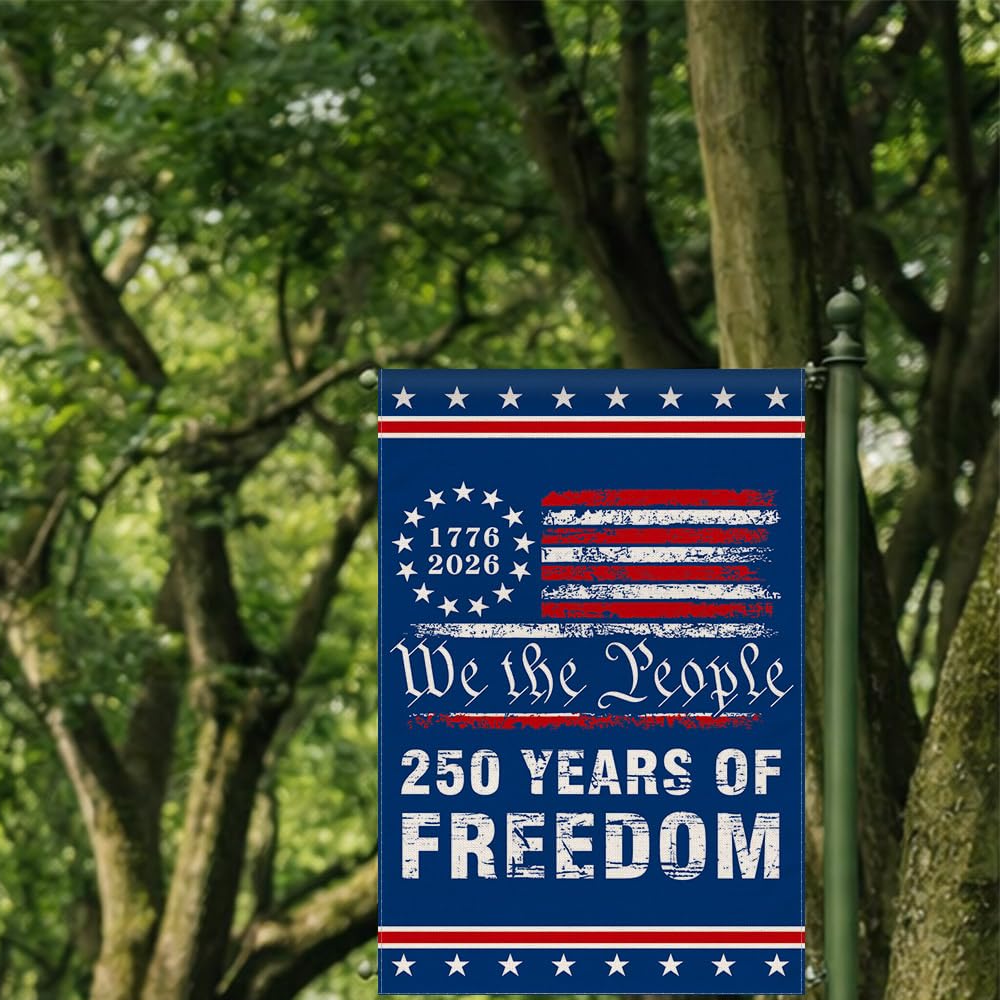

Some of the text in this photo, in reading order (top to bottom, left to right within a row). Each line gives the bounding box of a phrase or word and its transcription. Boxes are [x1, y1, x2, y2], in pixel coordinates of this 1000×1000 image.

[428, 527, 500, 548] 1776
[428, 554, 500, 575] 2026
[390, 637, 794, 716] We the People
[400, 748, 782, 796] 250 YEARS OF
[400, 811, 781, 881] FREEDOM
